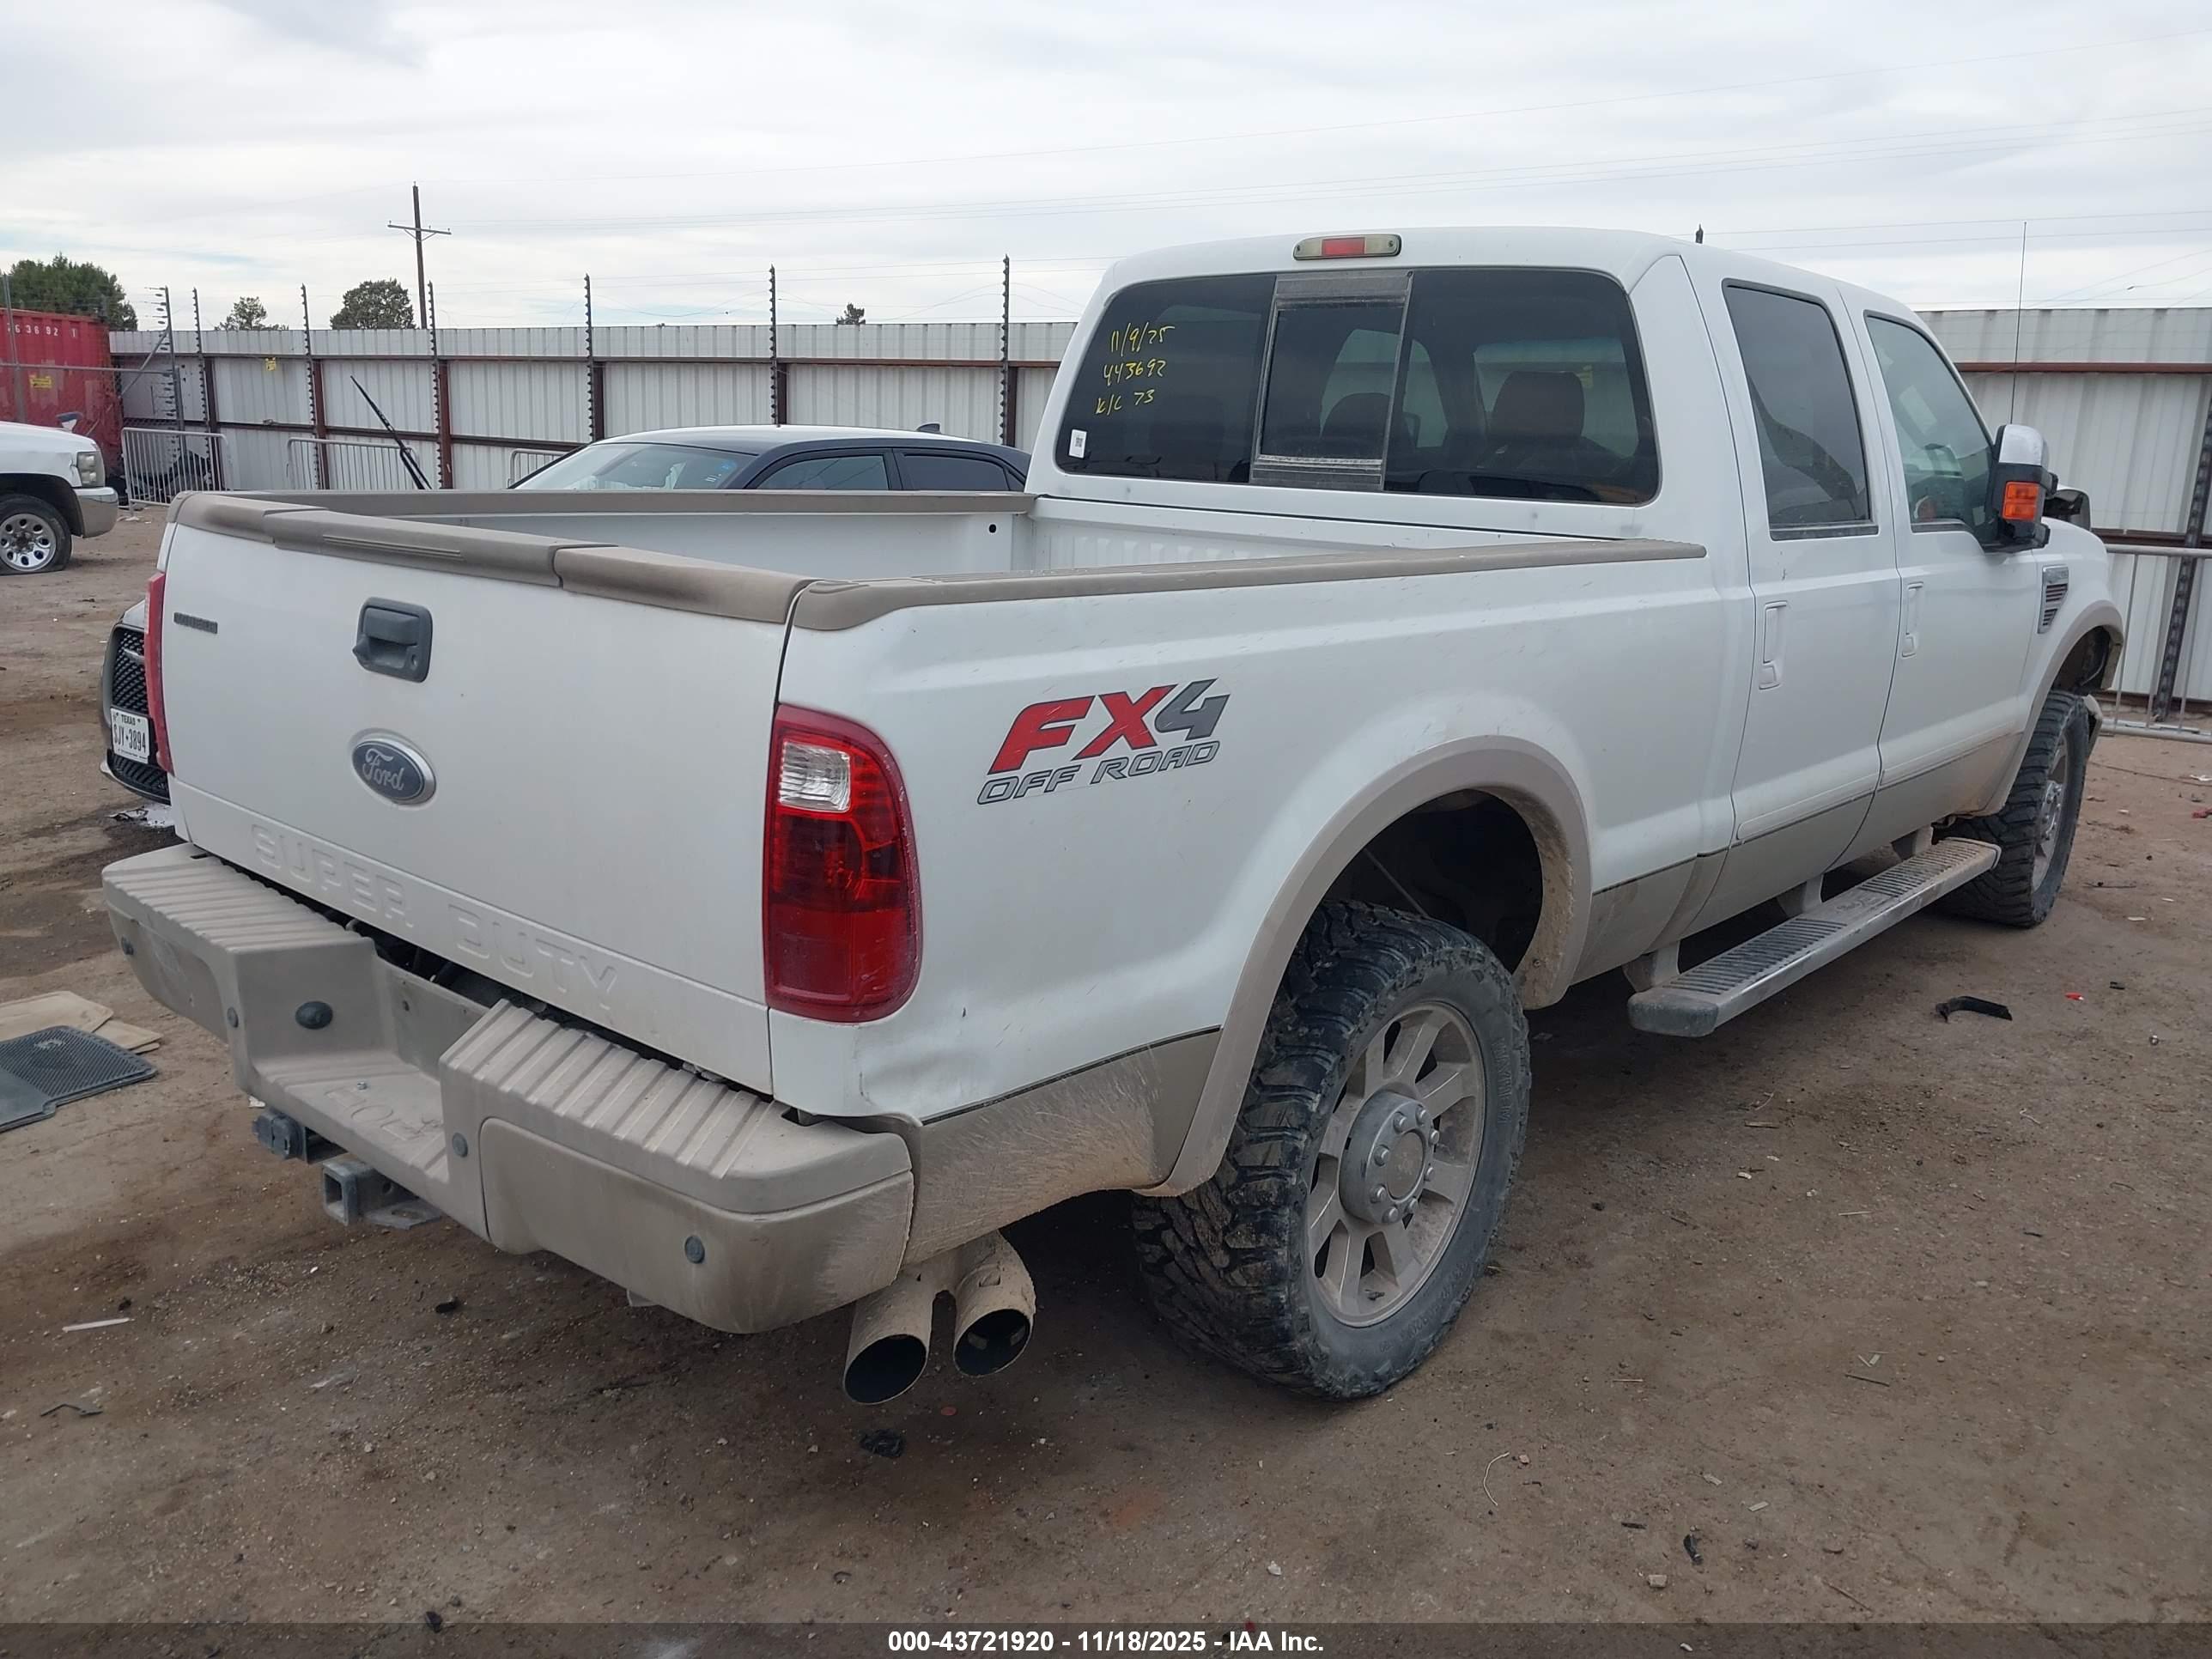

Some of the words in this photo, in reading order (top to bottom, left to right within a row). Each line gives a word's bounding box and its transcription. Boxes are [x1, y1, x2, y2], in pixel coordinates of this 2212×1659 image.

[1103, 358, 1166, 386] 443692
[1133, 389, 1155, 405] 73
[121, 714, 136, 726] TEXAS
[988, 678, 1231, 775] FX4
[362, 748, 405, 791] Ford
[977, 764, 1081, 805] OFF
[1090, 740, 1220, 785] ROAD
[252, 823, 414, 928] SUPER
[447, 904, 617, 1011] DUTY
